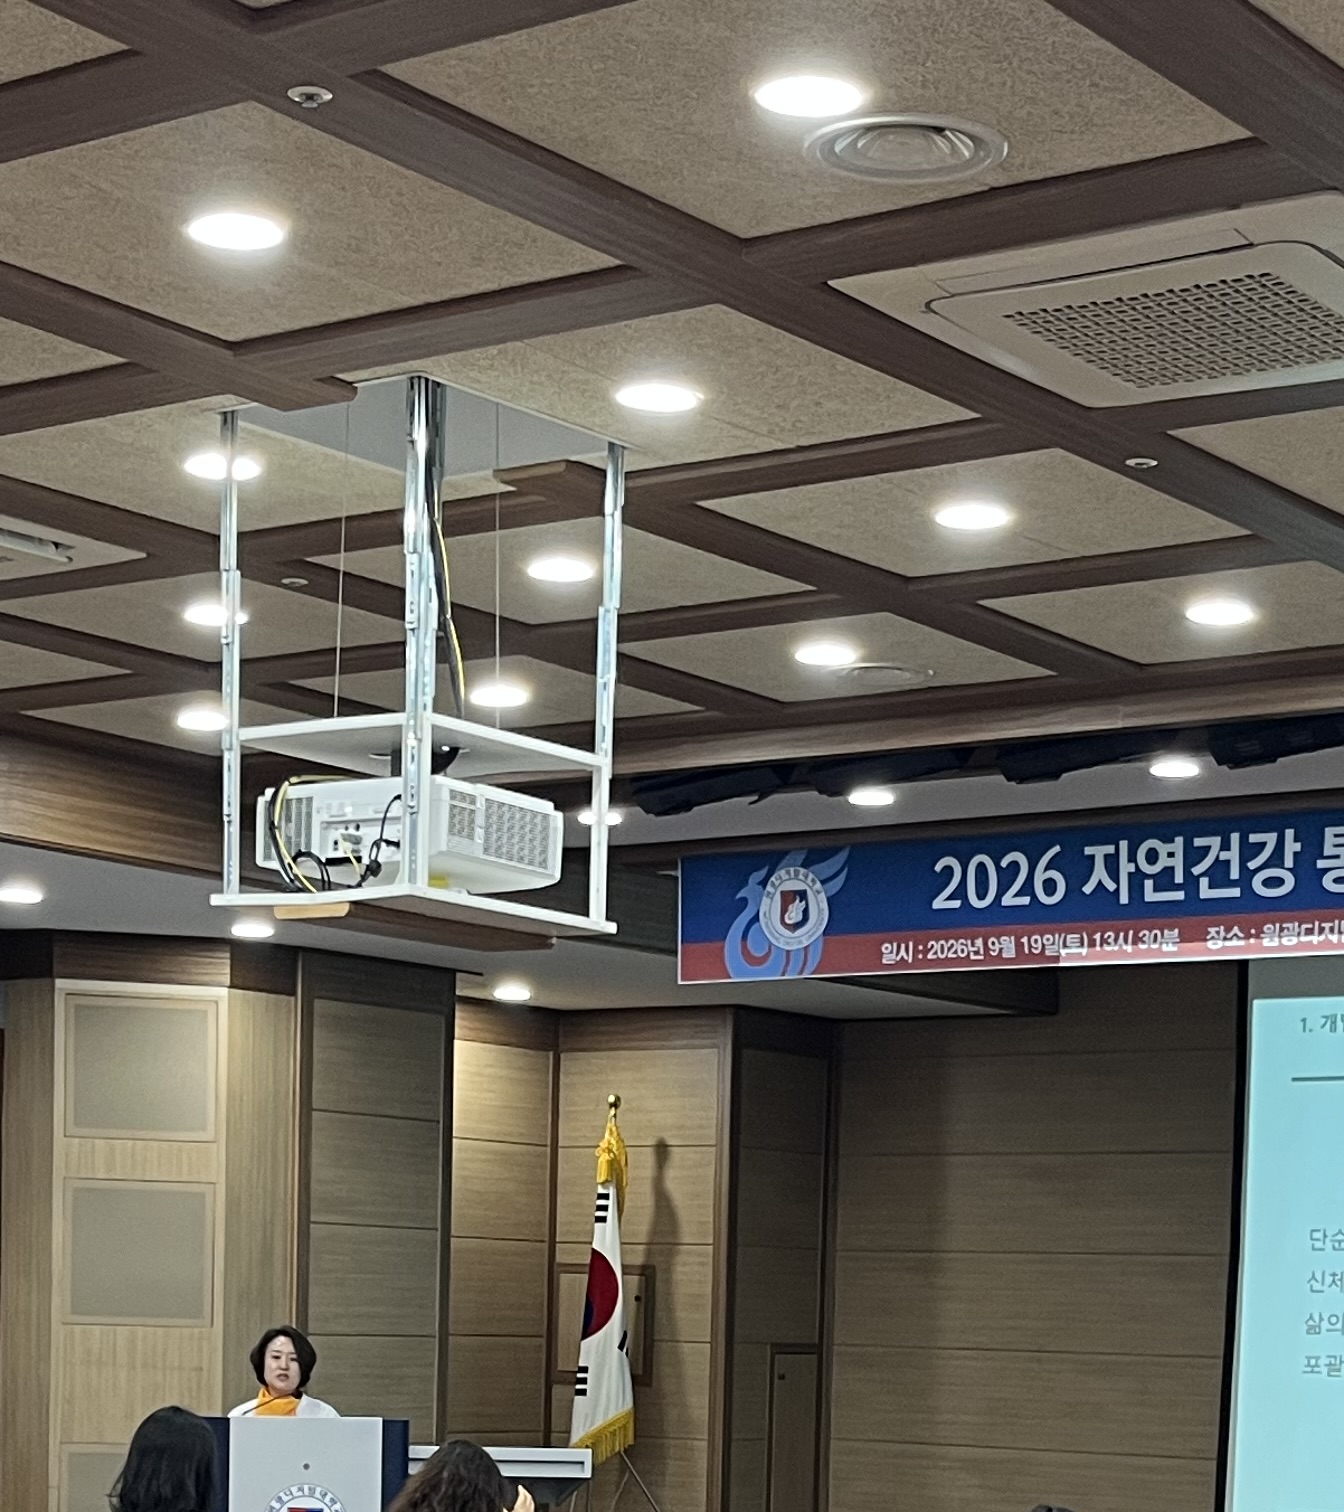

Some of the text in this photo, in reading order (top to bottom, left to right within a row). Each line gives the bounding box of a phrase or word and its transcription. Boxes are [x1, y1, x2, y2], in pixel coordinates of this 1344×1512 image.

[932, 845, 1067, 912] 2026
[1083, 831, 1299, 905] 자연건강
[881, 941, 913, 964] 일시
[927, 938, 985, 960] 2026년
[989, 935, 1016, 957] 9월
[1021, 932, 1088, 957] 19일(토)
[1094, 929, 1133, 952] 13시
[1137, 927, 1180, 951] 30분
[1206, 926, 1245, 949] 장소
[1299, 1018, 1314, 1033] 1.
